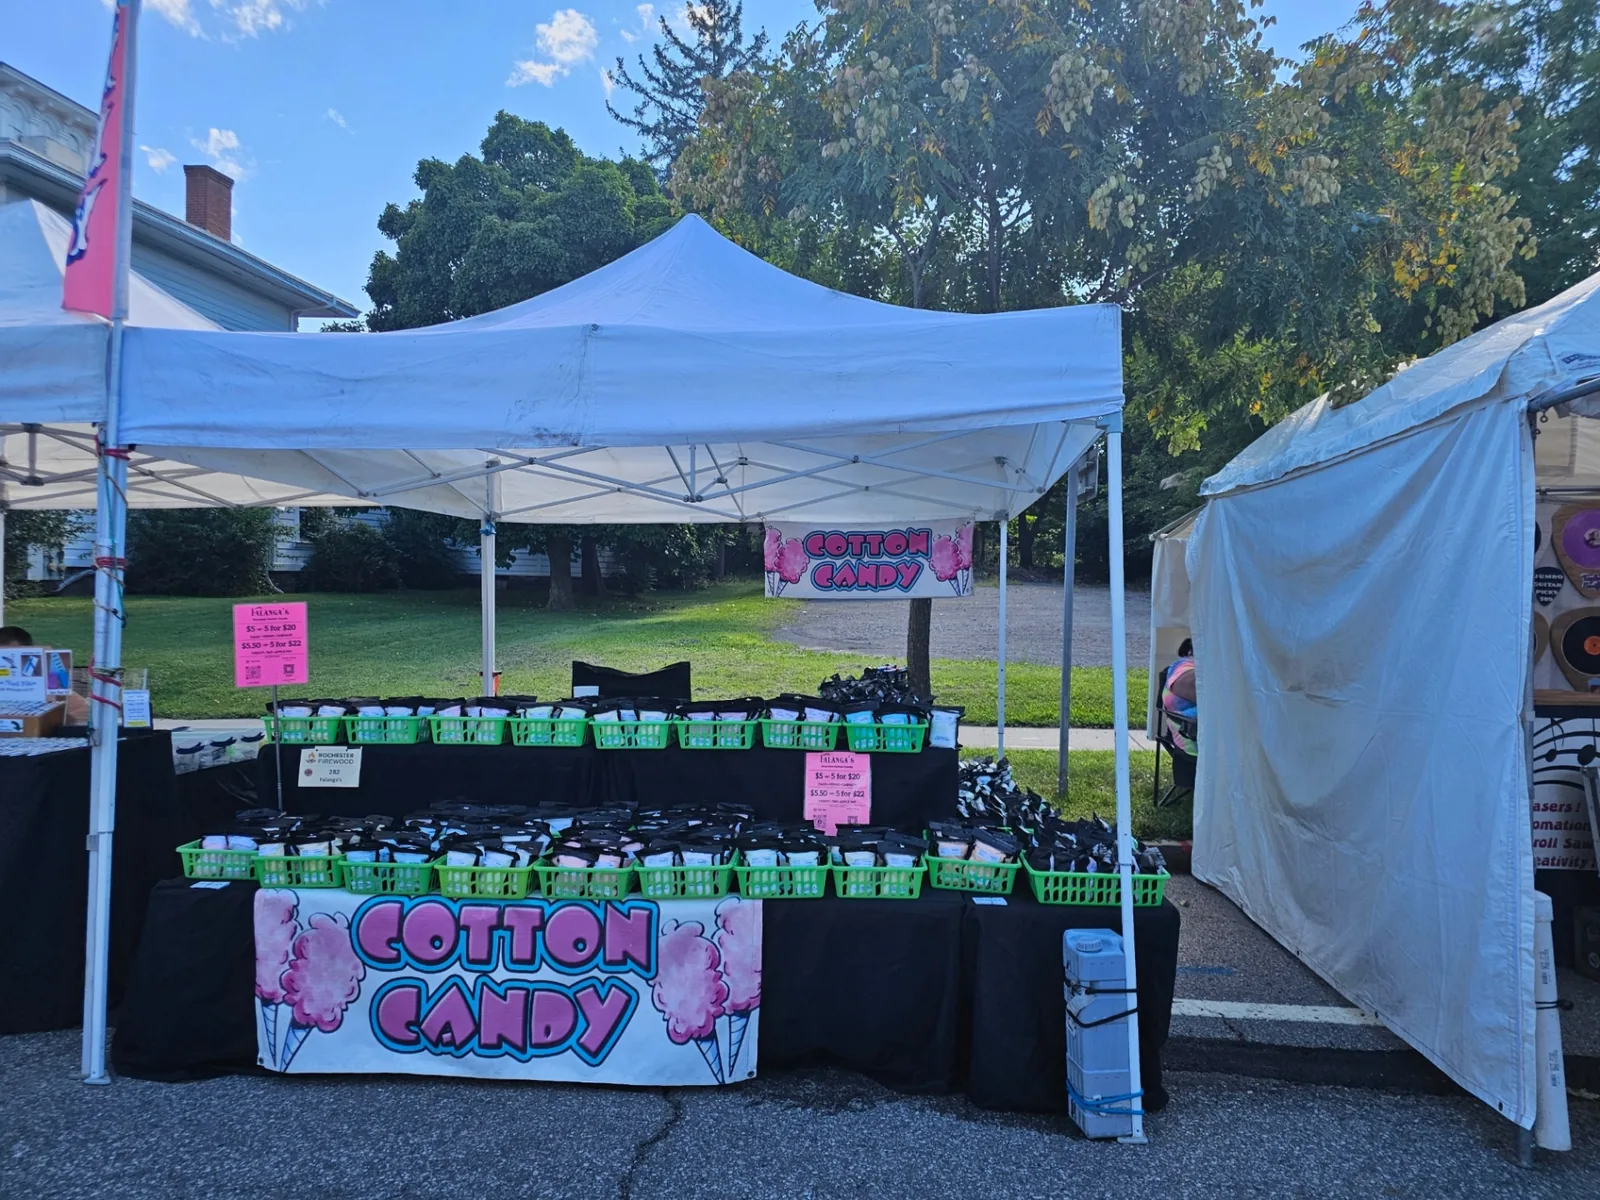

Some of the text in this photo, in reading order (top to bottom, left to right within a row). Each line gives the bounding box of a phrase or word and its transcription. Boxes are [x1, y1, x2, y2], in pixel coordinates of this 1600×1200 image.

[803, 529, 931, 558] COTTON
[812, 560, 922, 591] CANDY
[251, 606, 290, 617] FALANGA'S
[241, 642, 261, 650] $5.50
[820, 753, 855, 764] FALANGA'S
[815, 772, 823, 780] $5
[352, 897, 656, 975] COTTON
[371, 977, 635, 1062] CANDY
